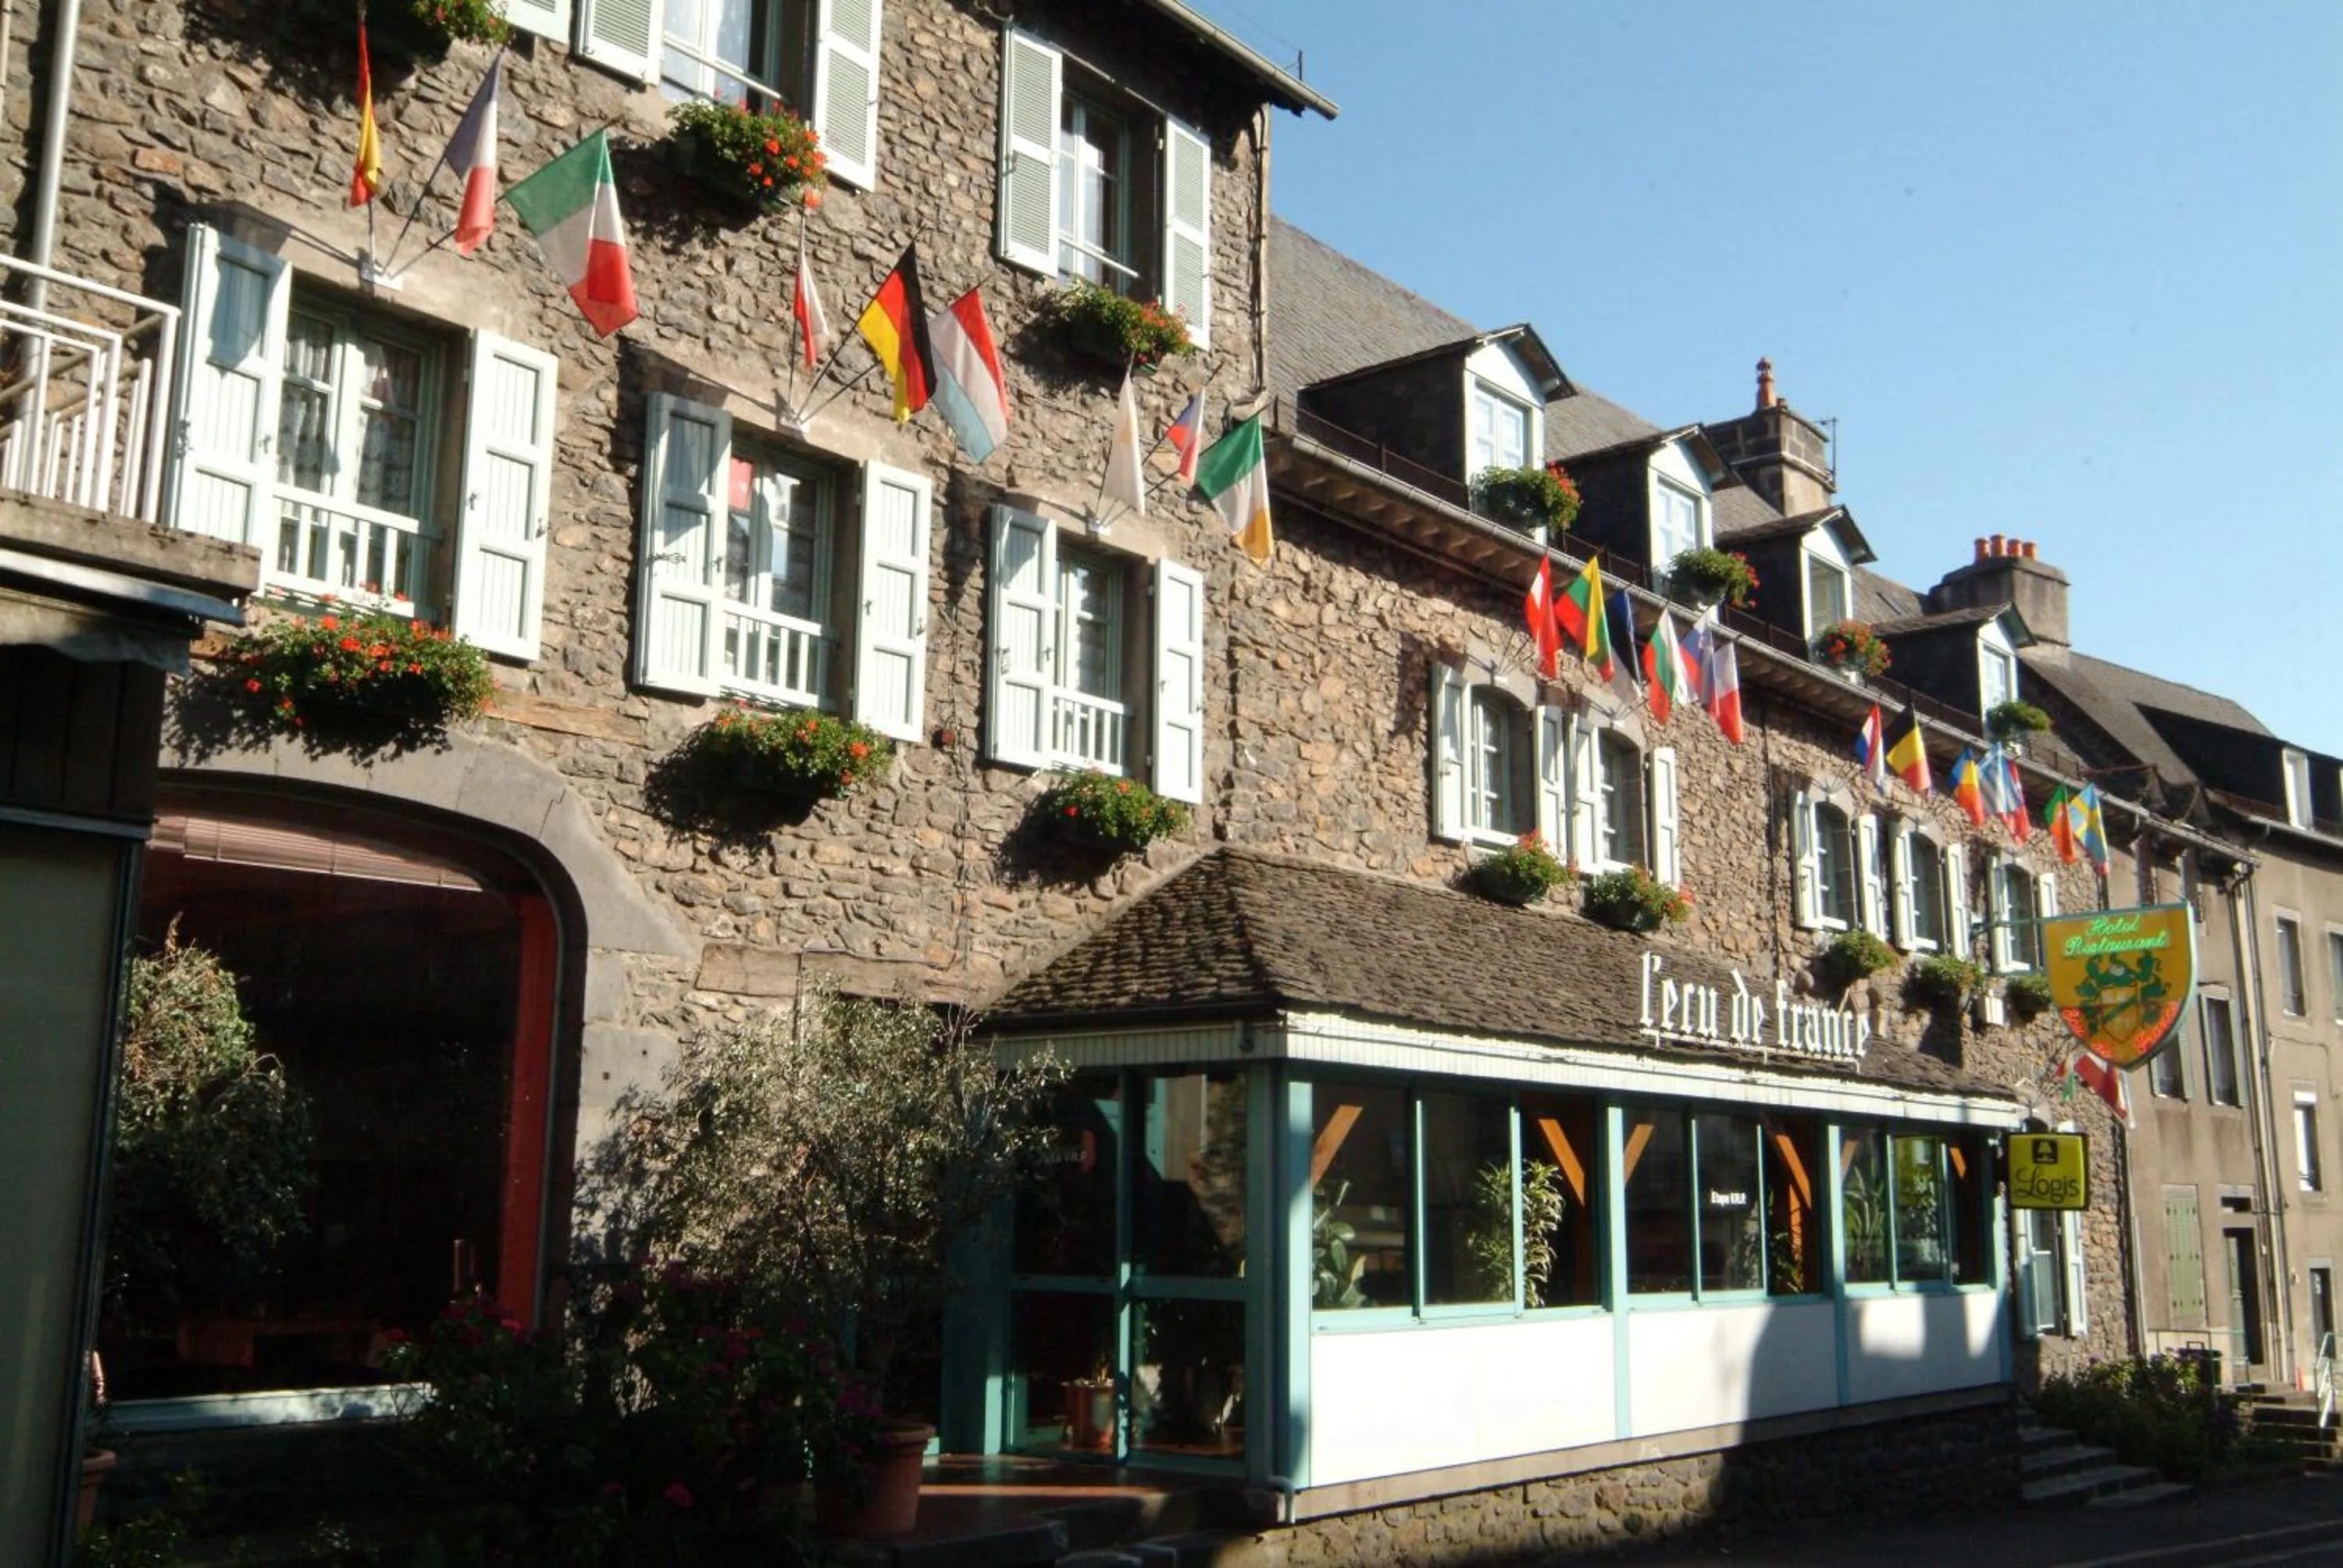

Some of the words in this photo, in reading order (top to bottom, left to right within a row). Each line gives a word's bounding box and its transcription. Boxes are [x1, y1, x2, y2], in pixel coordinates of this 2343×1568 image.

[2064, 929, 2167, 957] Restaurant
[1731, 968, 1767, 1045] de
[2013, 1166, 2080, 1203] Logis
